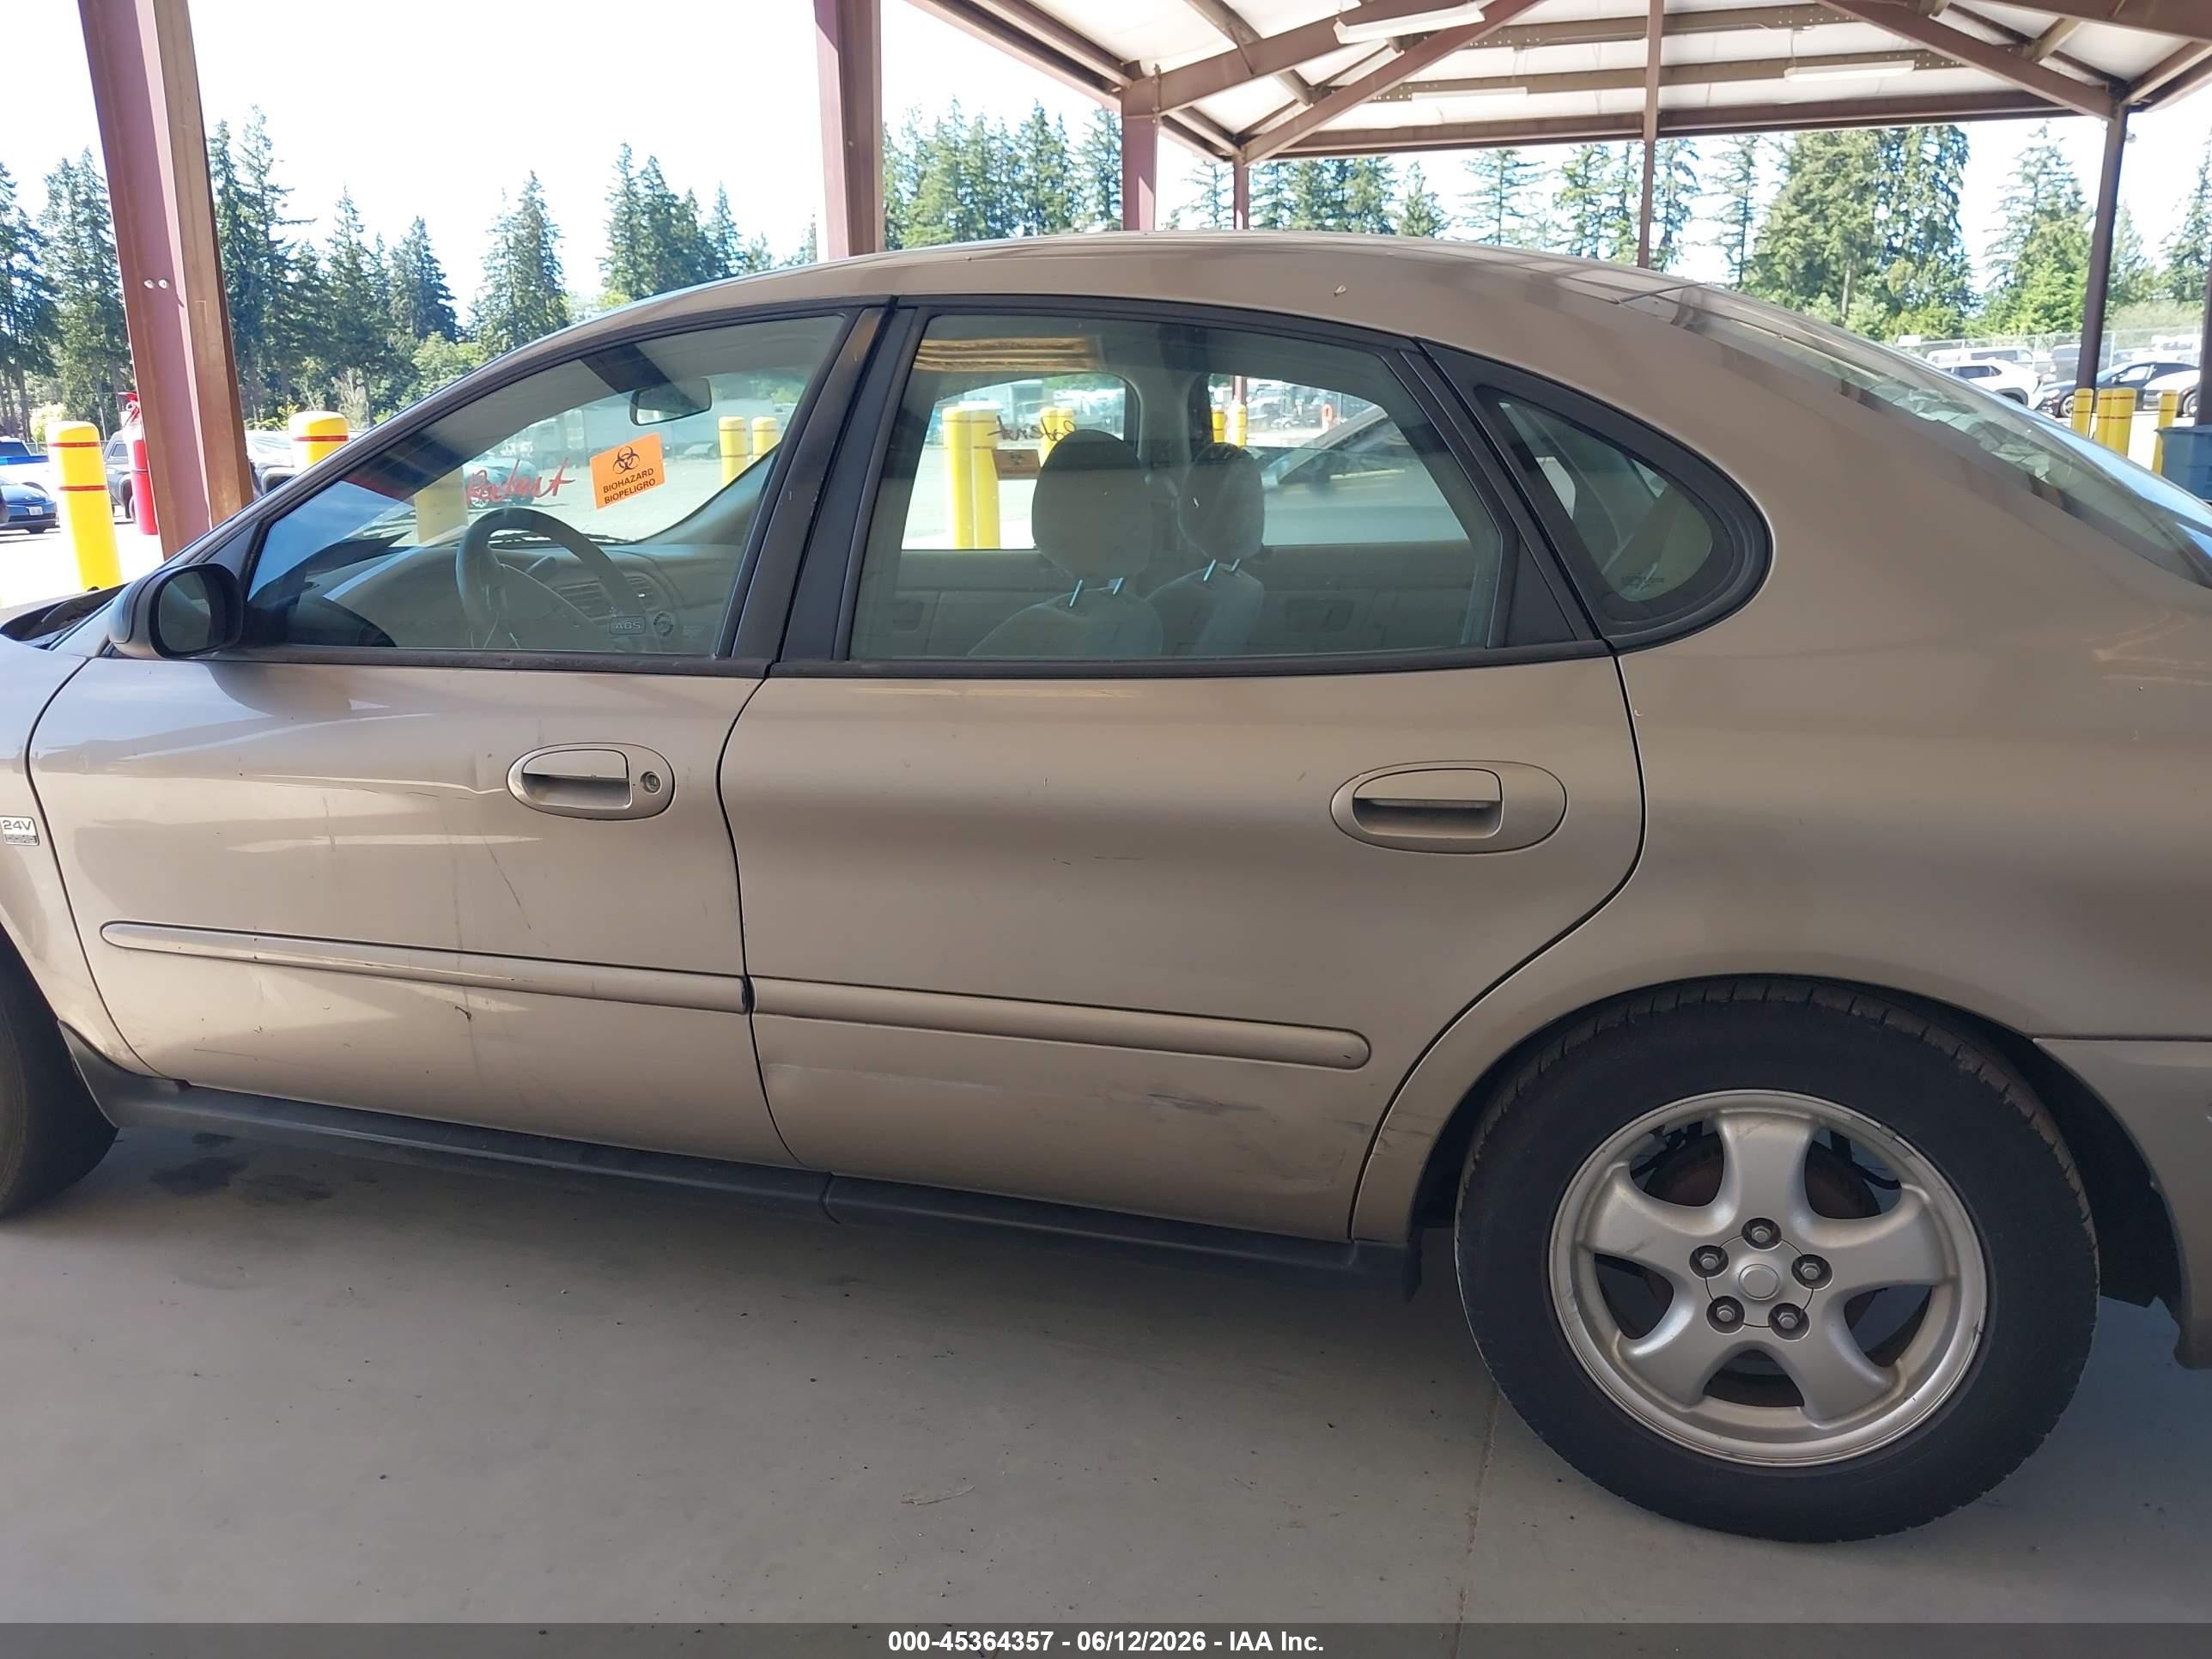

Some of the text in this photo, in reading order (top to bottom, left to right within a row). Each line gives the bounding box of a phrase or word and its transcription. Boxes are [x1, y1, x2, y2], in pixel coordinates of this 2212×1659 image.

[603, 467, 654, 494] BIOHAZARD
[604, 477, 656, 504] BIOPELIGRO
[615, 621, 641, 629] ABS
[2, 819, 32, 831] 24V
